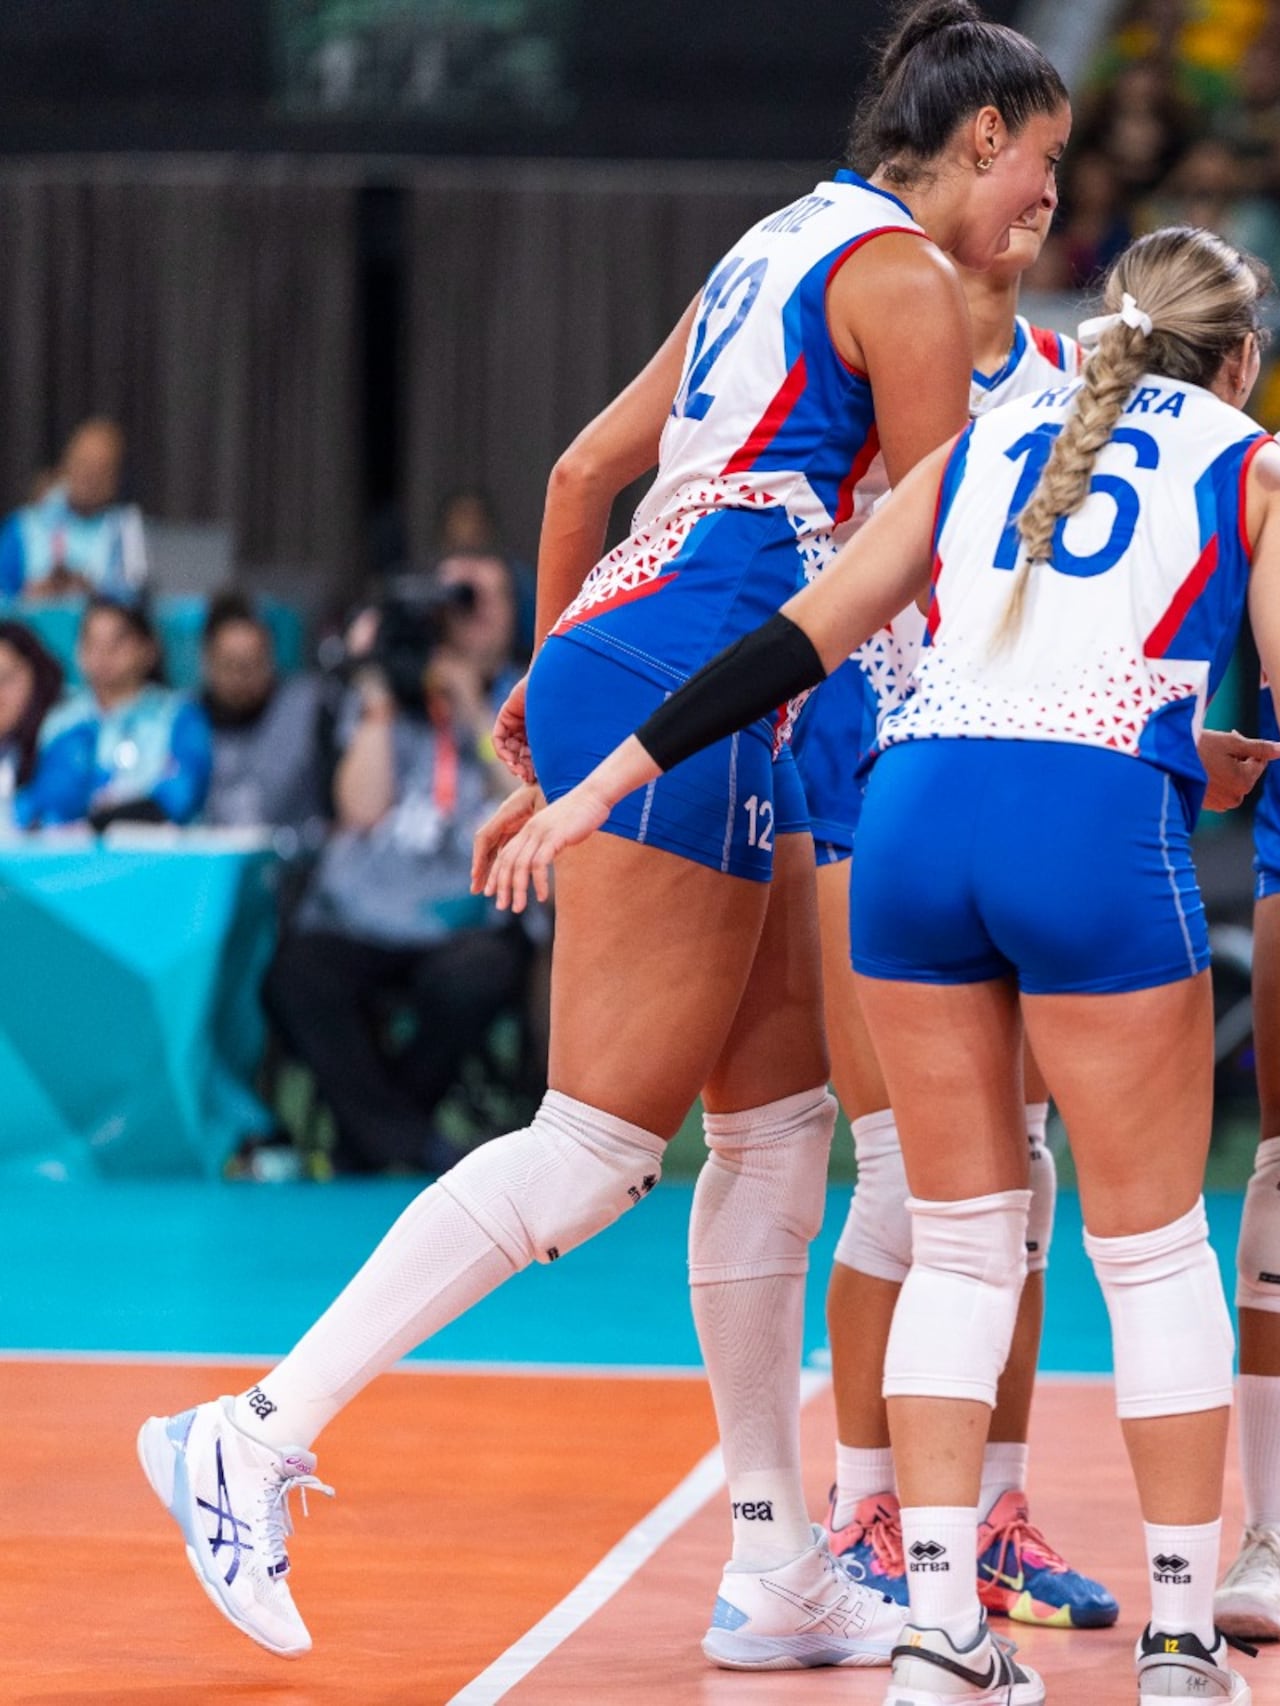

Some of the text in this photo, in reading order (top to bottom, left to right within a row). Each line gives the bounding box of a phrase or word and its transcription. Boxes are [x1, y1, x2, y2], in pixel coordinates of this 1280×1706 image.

[671, 257, 768, 421] 12
[1032, 383, 1187, 418] RIRA
[993, 422, 1160, 578] 16
[744, 794, 774, 852] 12
[910, 1562, 949, 1572] errea
[1153, 1572, 1191, 1584] errea
